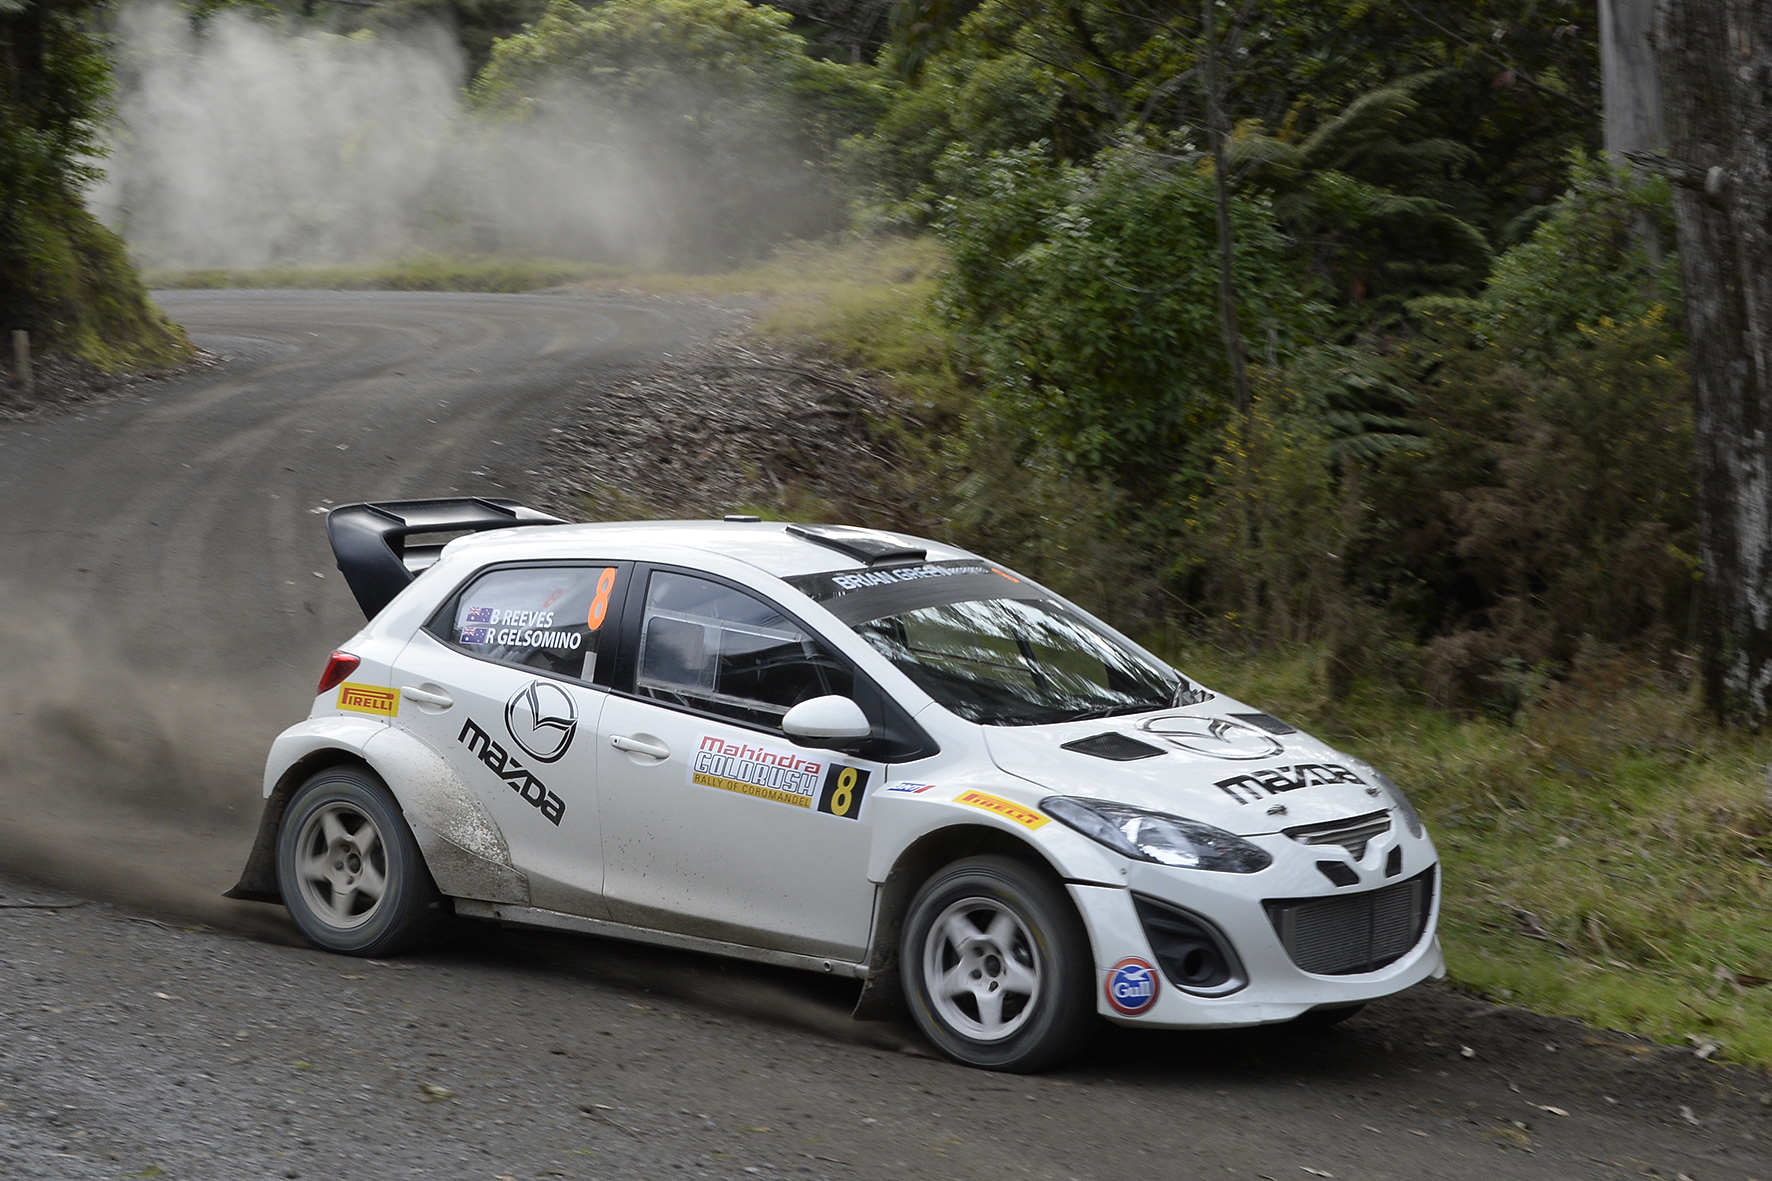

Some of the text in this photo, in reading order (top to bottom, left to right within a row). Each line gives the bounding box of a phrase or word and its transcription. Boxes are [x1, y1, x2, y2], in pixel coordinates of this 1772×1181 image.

[832, 571, 893, 590] BRIAN
[892, 565, 951, 582] GREEN
[587, 566, 616, 631] 8
[490, 609, 554, 628] B REEVES
[485, 627, 582, 650] R GELSOMINO
[341, 687, 395, 711] PIRELLI
[700, 736, 821, 774] Mahindra
[694, 750, 819, 797] GOLDRUSH
[694, 775, 811, 808] RALLY OF COROMANDEL
[830, 767, 858, 816] 8
[962, 793, 1040, 824] PIRELLI
[1114, 982, 1151, 998] Gull
